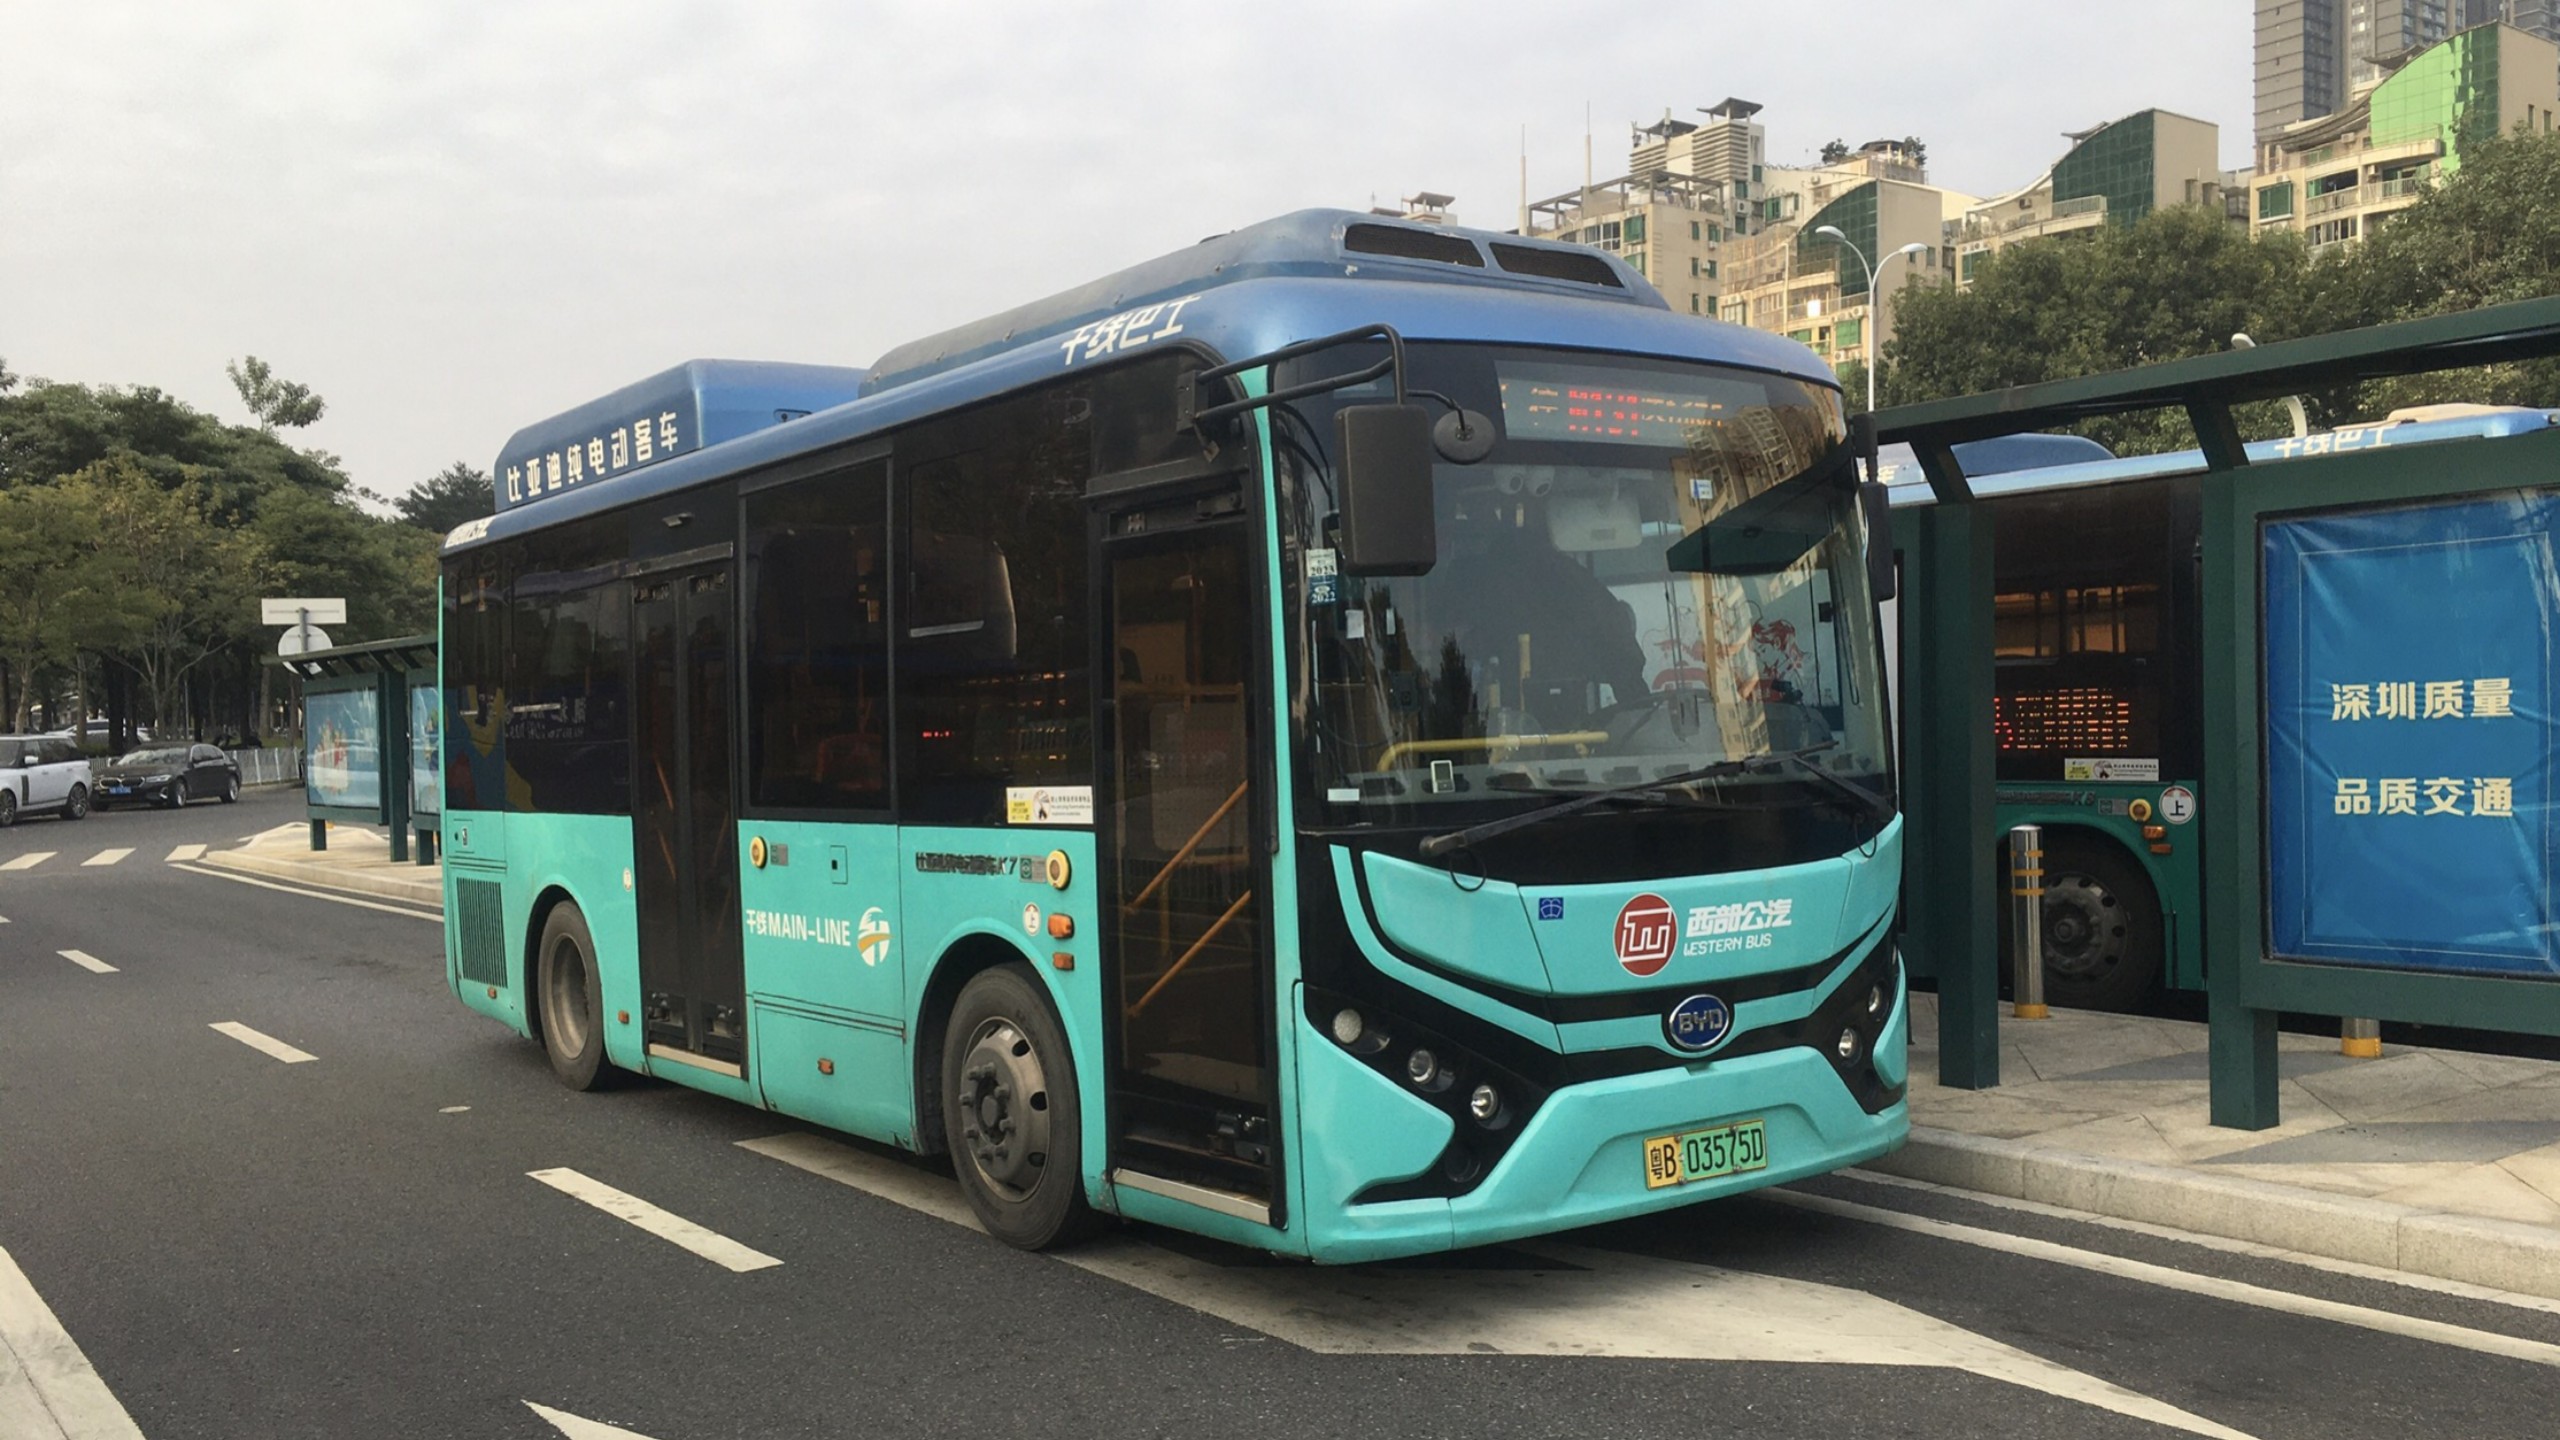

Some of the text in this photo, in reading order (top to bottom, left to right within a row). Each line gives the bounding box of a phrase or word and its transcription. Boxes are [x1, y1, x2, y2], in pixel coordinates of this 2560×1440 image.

[507, 411, 678, 502] 比亚迪纯电动客车
[2331, 677, 2514, 721] 深圳质量
[2169, 800, 2186, 817] 上
[2334, 777, 2514, 817] 品质交通
[1686, 899, 1793, 938] 西部公汽
[1745, 932, 1773, 950] BUS
[1678, 1007, 1723, 1034] BYD
[1686, 1127, 1764, 1174] 03575D
